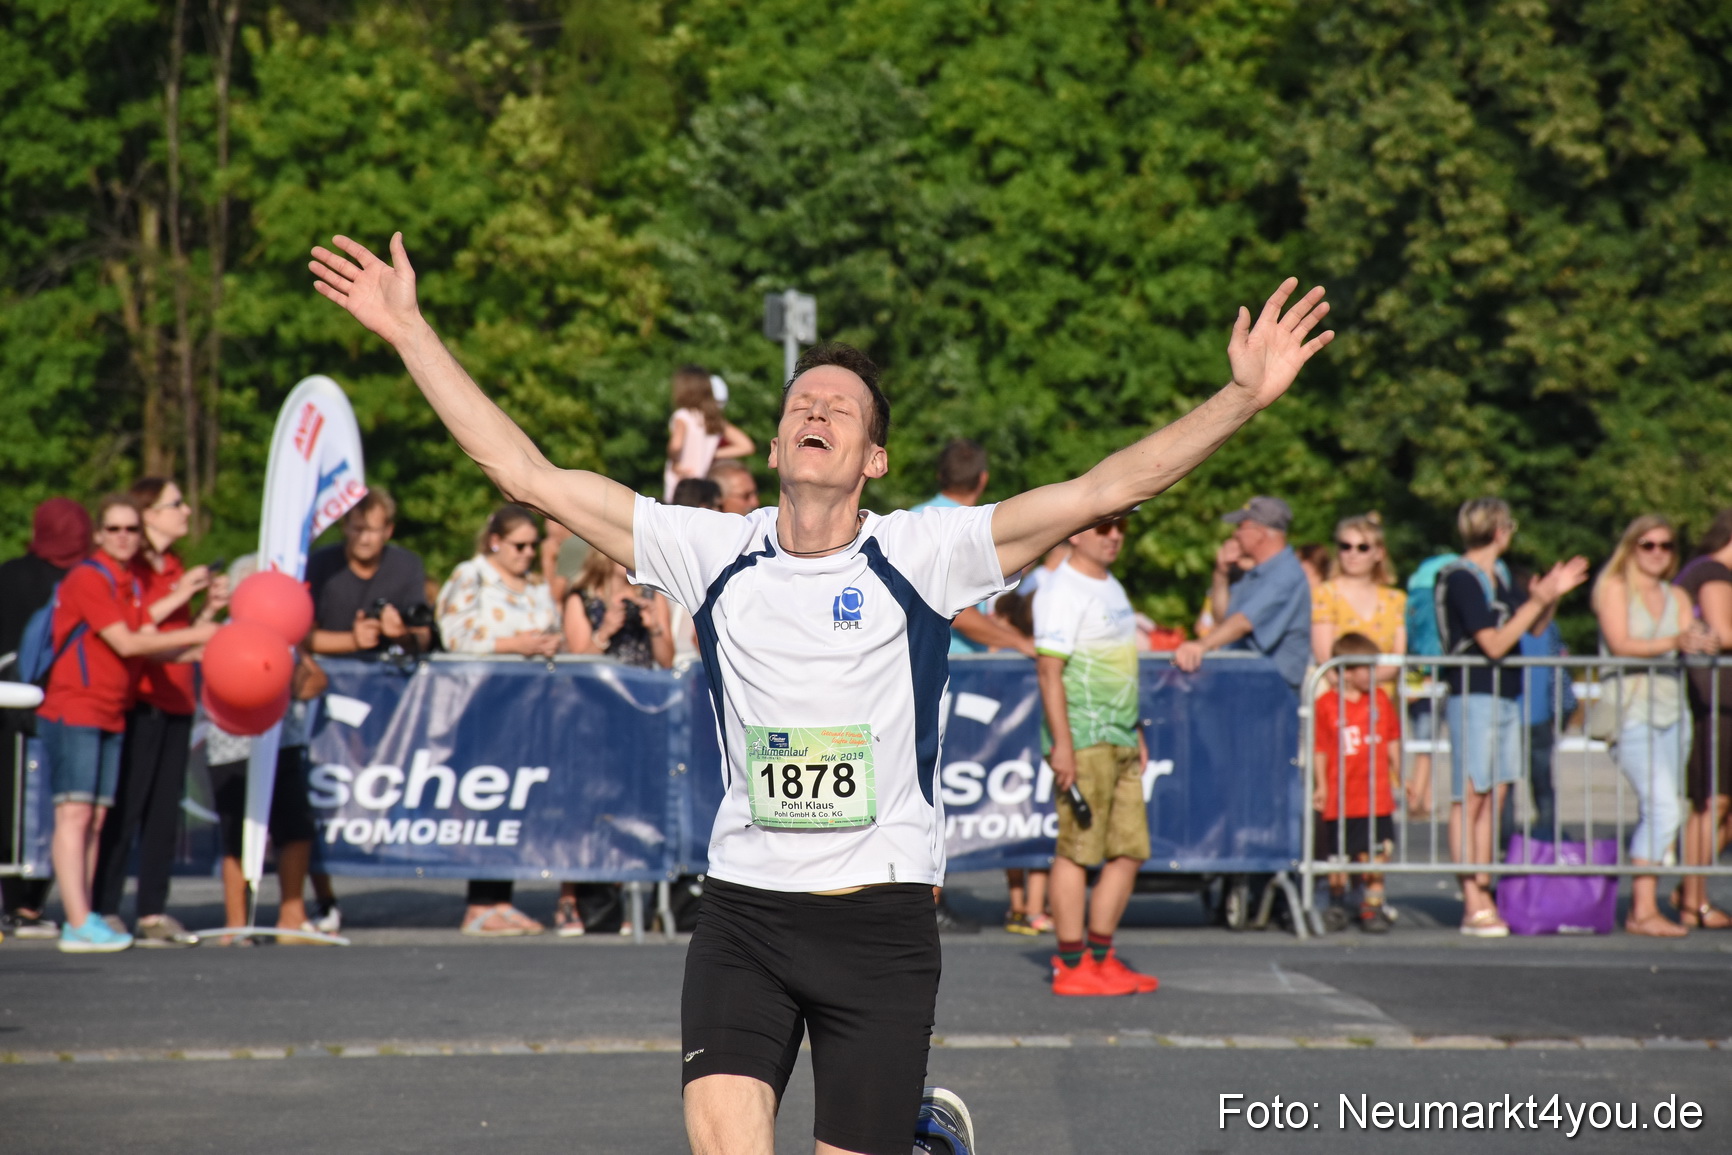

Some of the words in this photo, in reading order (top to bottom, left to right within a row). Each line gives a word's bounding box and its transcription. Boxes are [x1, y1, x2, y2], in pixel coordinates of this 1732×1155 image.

[833, 620, 863, 631] POHL
[761, 746, 809, 757] firmenlauf
[840, 751, 864, 761] 2019
[760, 763, 856, 799] 1878
[781, 801, 803, 810] Pohl
[805, 801, 835, 810] Klaus
[315, 818, 522, 846] TOMOBILE
